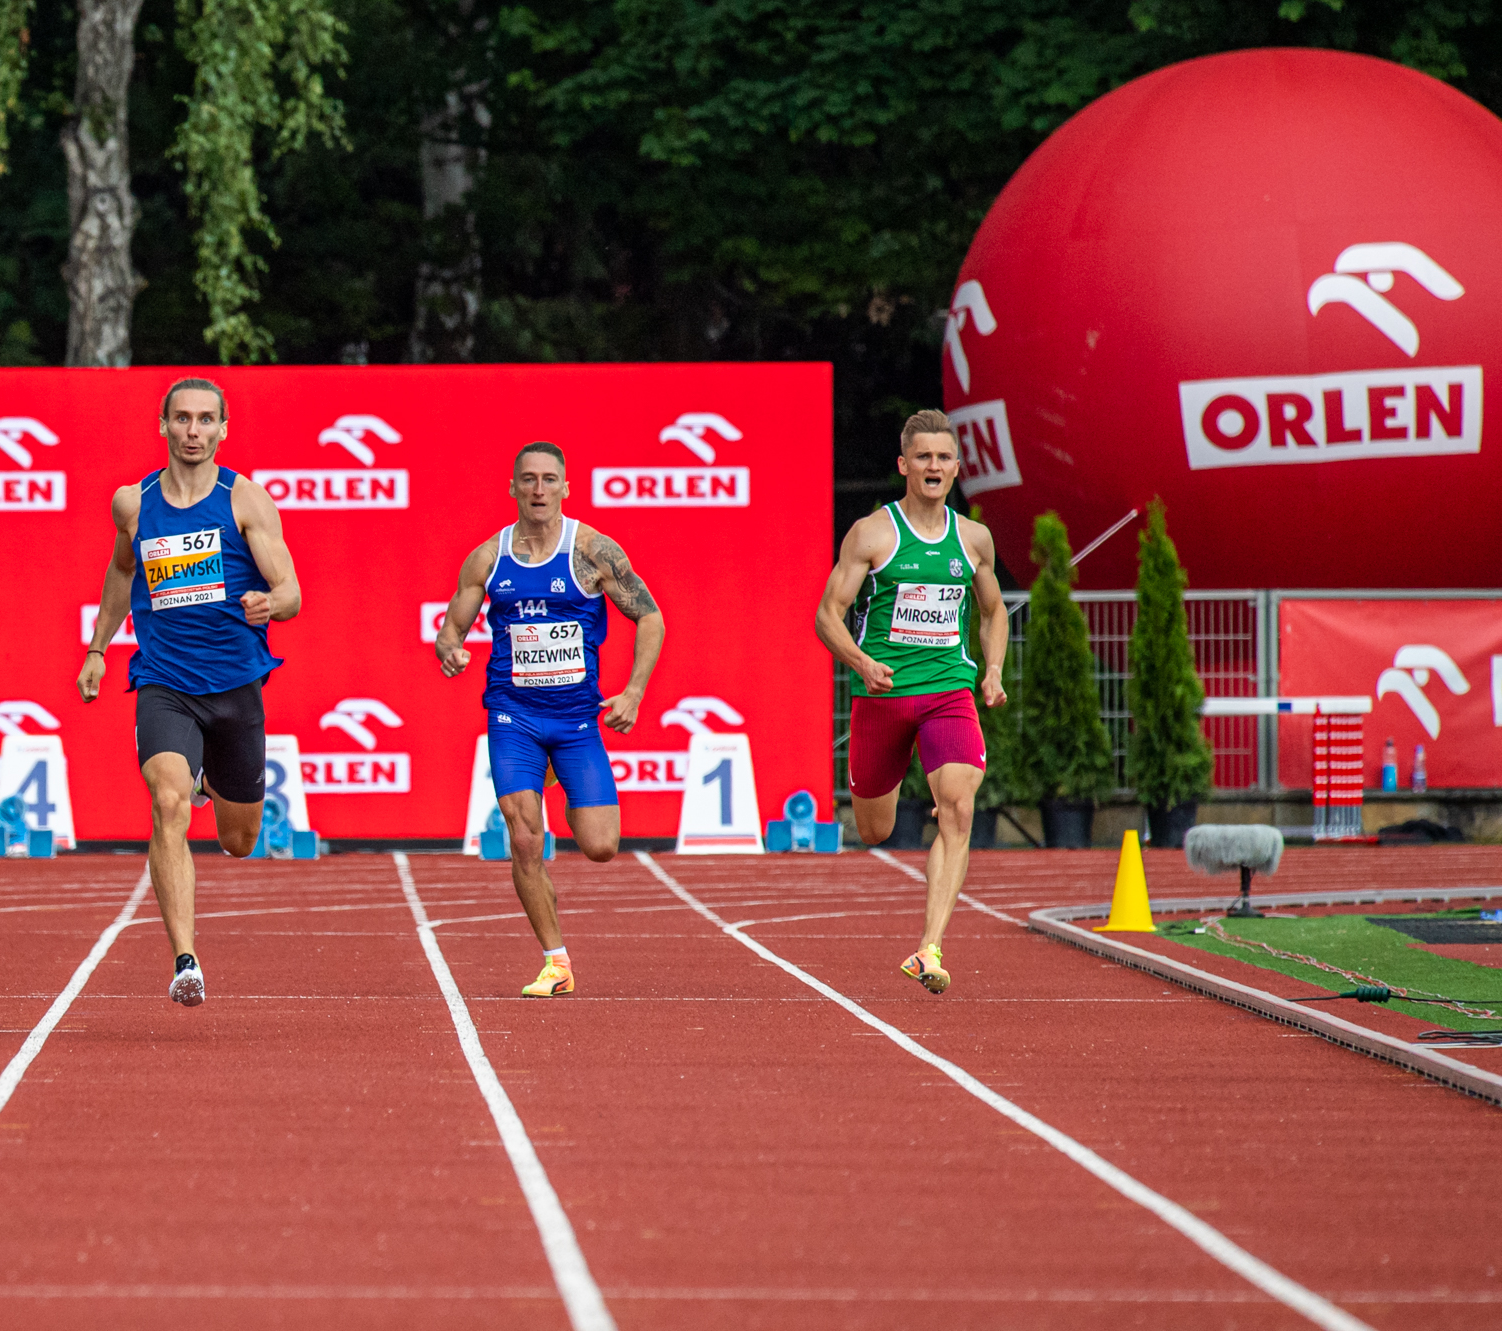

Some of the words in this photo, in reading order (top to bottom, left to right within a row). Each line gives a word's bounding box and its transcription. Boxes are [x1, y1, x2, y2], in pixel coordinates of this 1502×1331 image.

[1201, 381, 1464, 452] ORLEN
[264, 477, 396, 501] ORLEN
[602, 475, 737, 500] ORLEN
[183, 532, 215, 552] 567
[148, 558, 222, 584] ZALEWSKI
[159, 593, 193, 606] POZNAŃ
[195, 592, 214, 602] 2021
[938, 587, 963, 602] 123
[515, 599, 549, 619] 144
[896, 606, 958, 624] MIROSŁAW
[549, 623, 579, 640] 657
[514, 646, 581, 665] KRZEWINA
[557, 675, 574, 683] 2021
[17, 759, 56, 829] 4
[702, 757, 733, 827] 1
